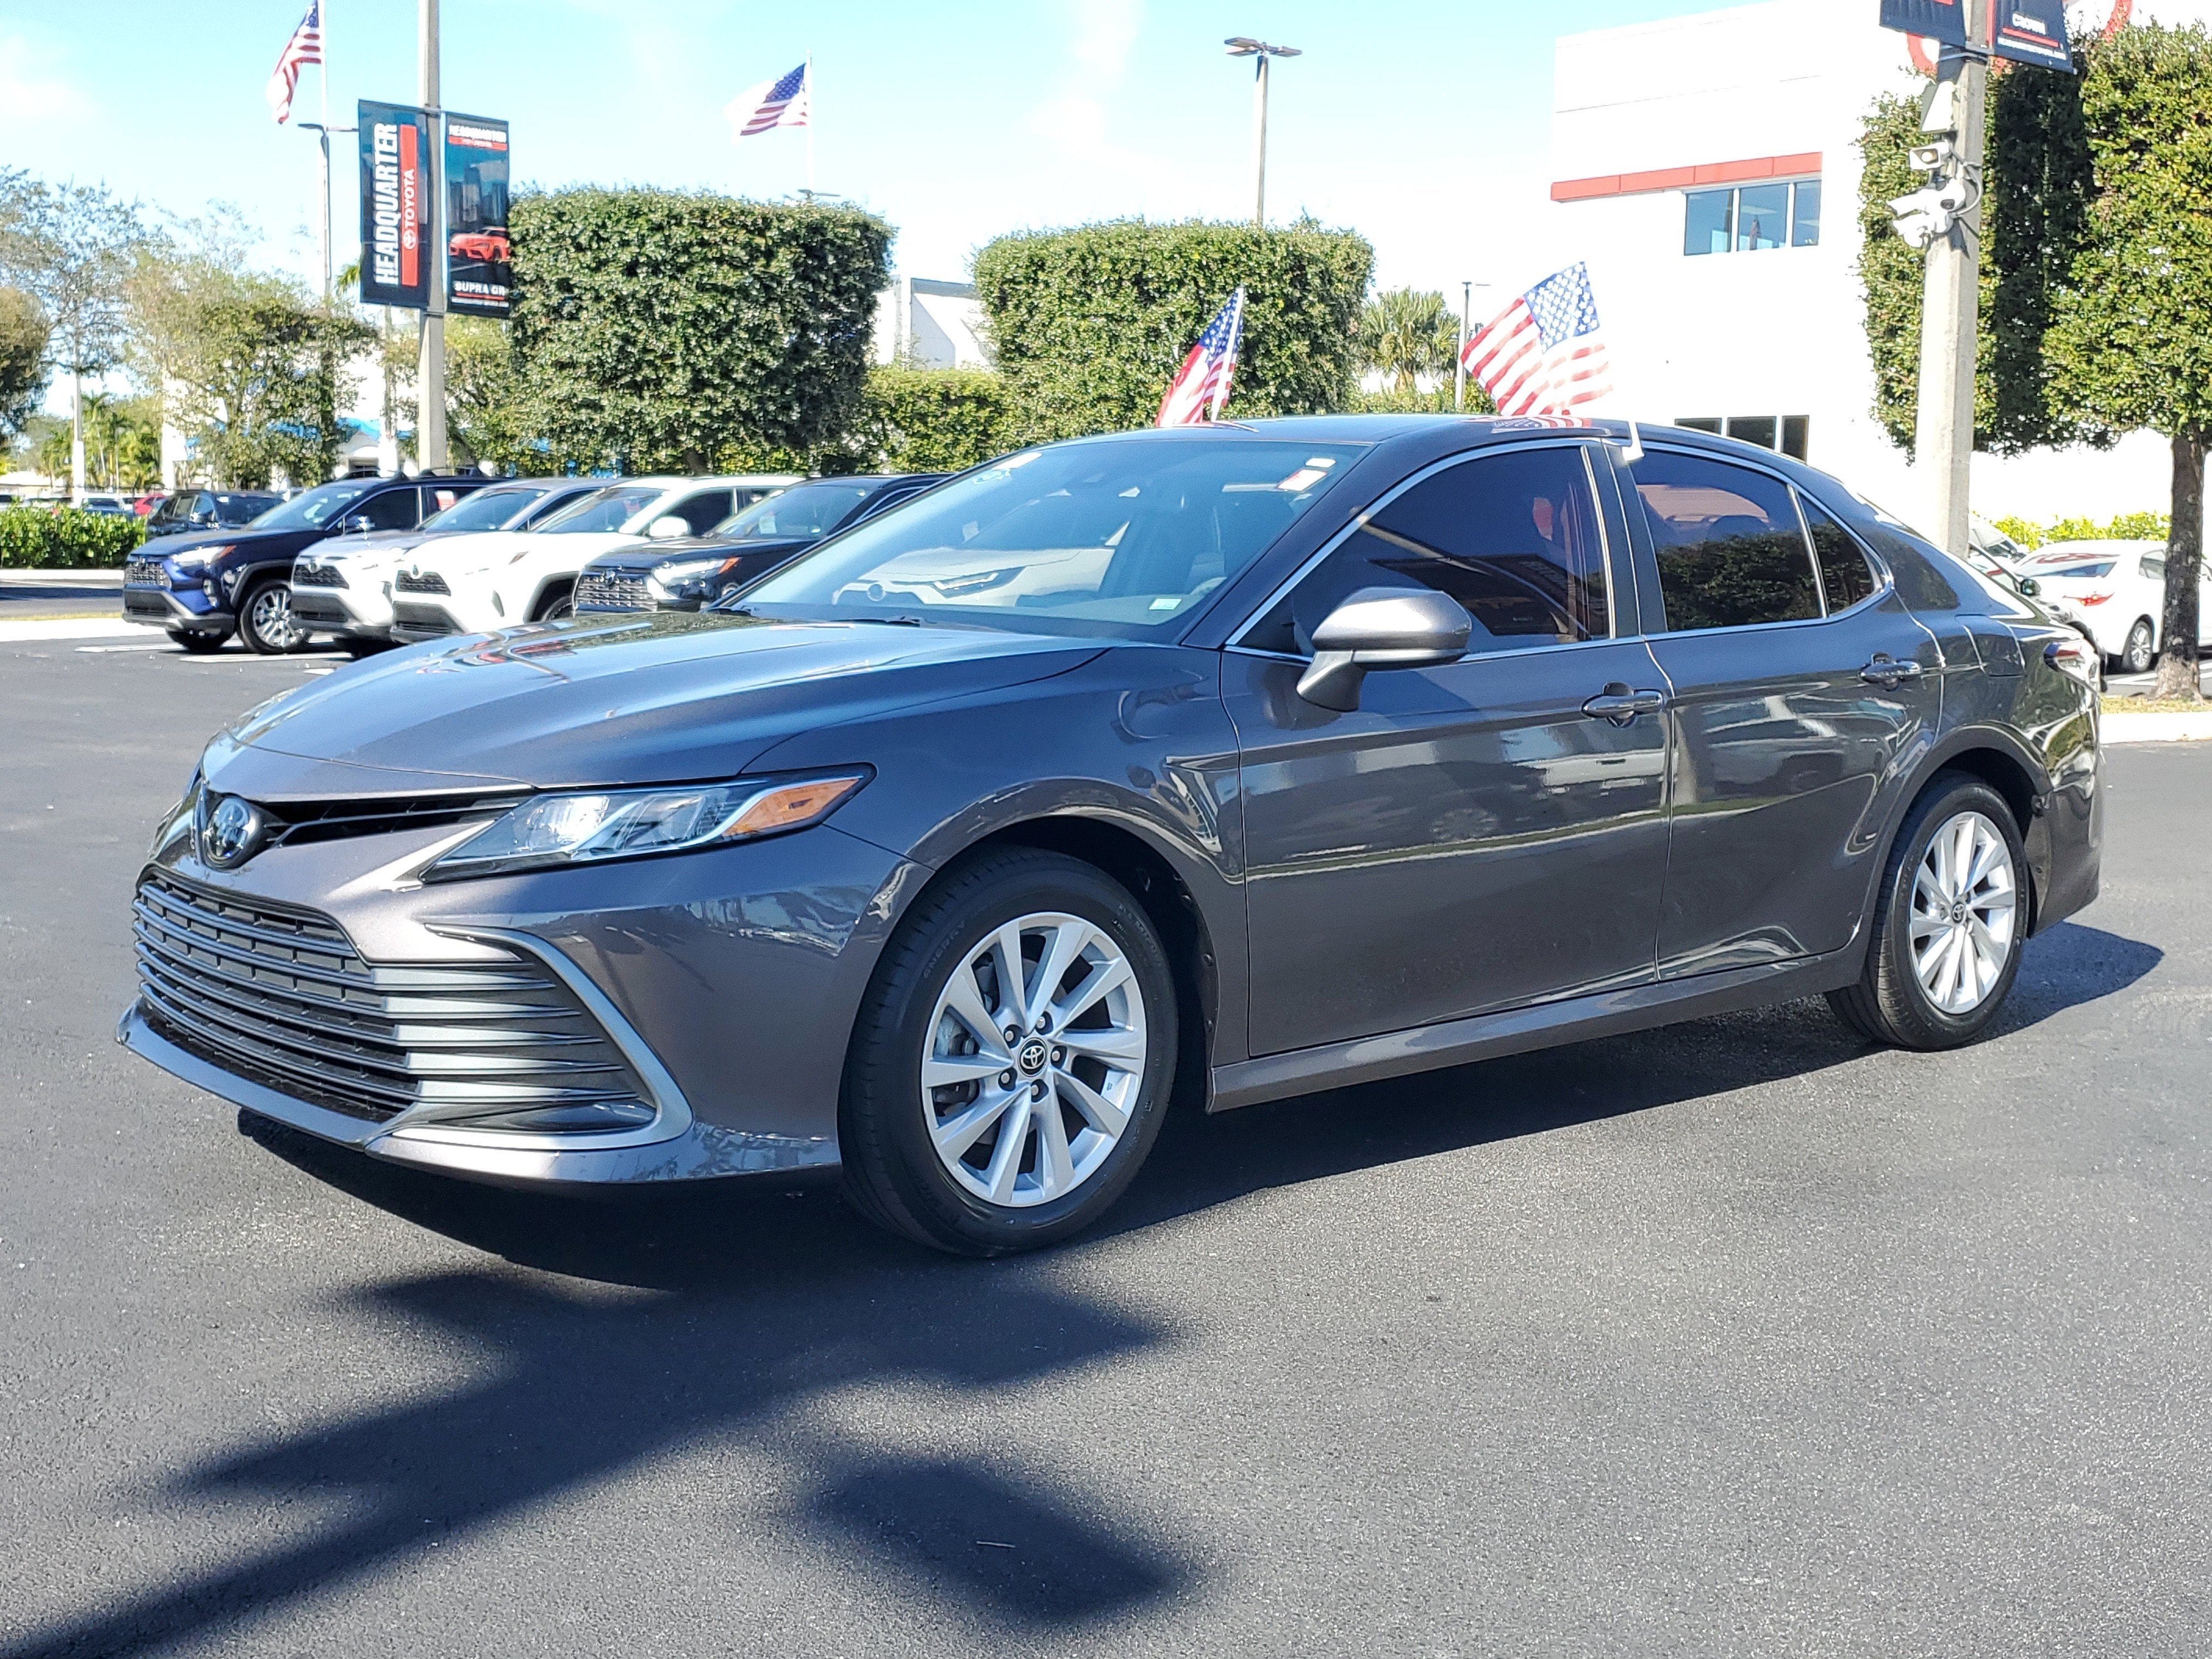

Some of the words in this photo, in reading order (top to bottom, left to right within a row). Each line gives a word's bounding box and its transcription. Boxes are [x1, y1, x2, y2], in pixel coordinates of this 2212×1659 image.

[374, 123, 401, 285] HEADQUARTER
[404, 168, 415, 229] TOYOTA
[454, 280, 489, 294] SUPRA
